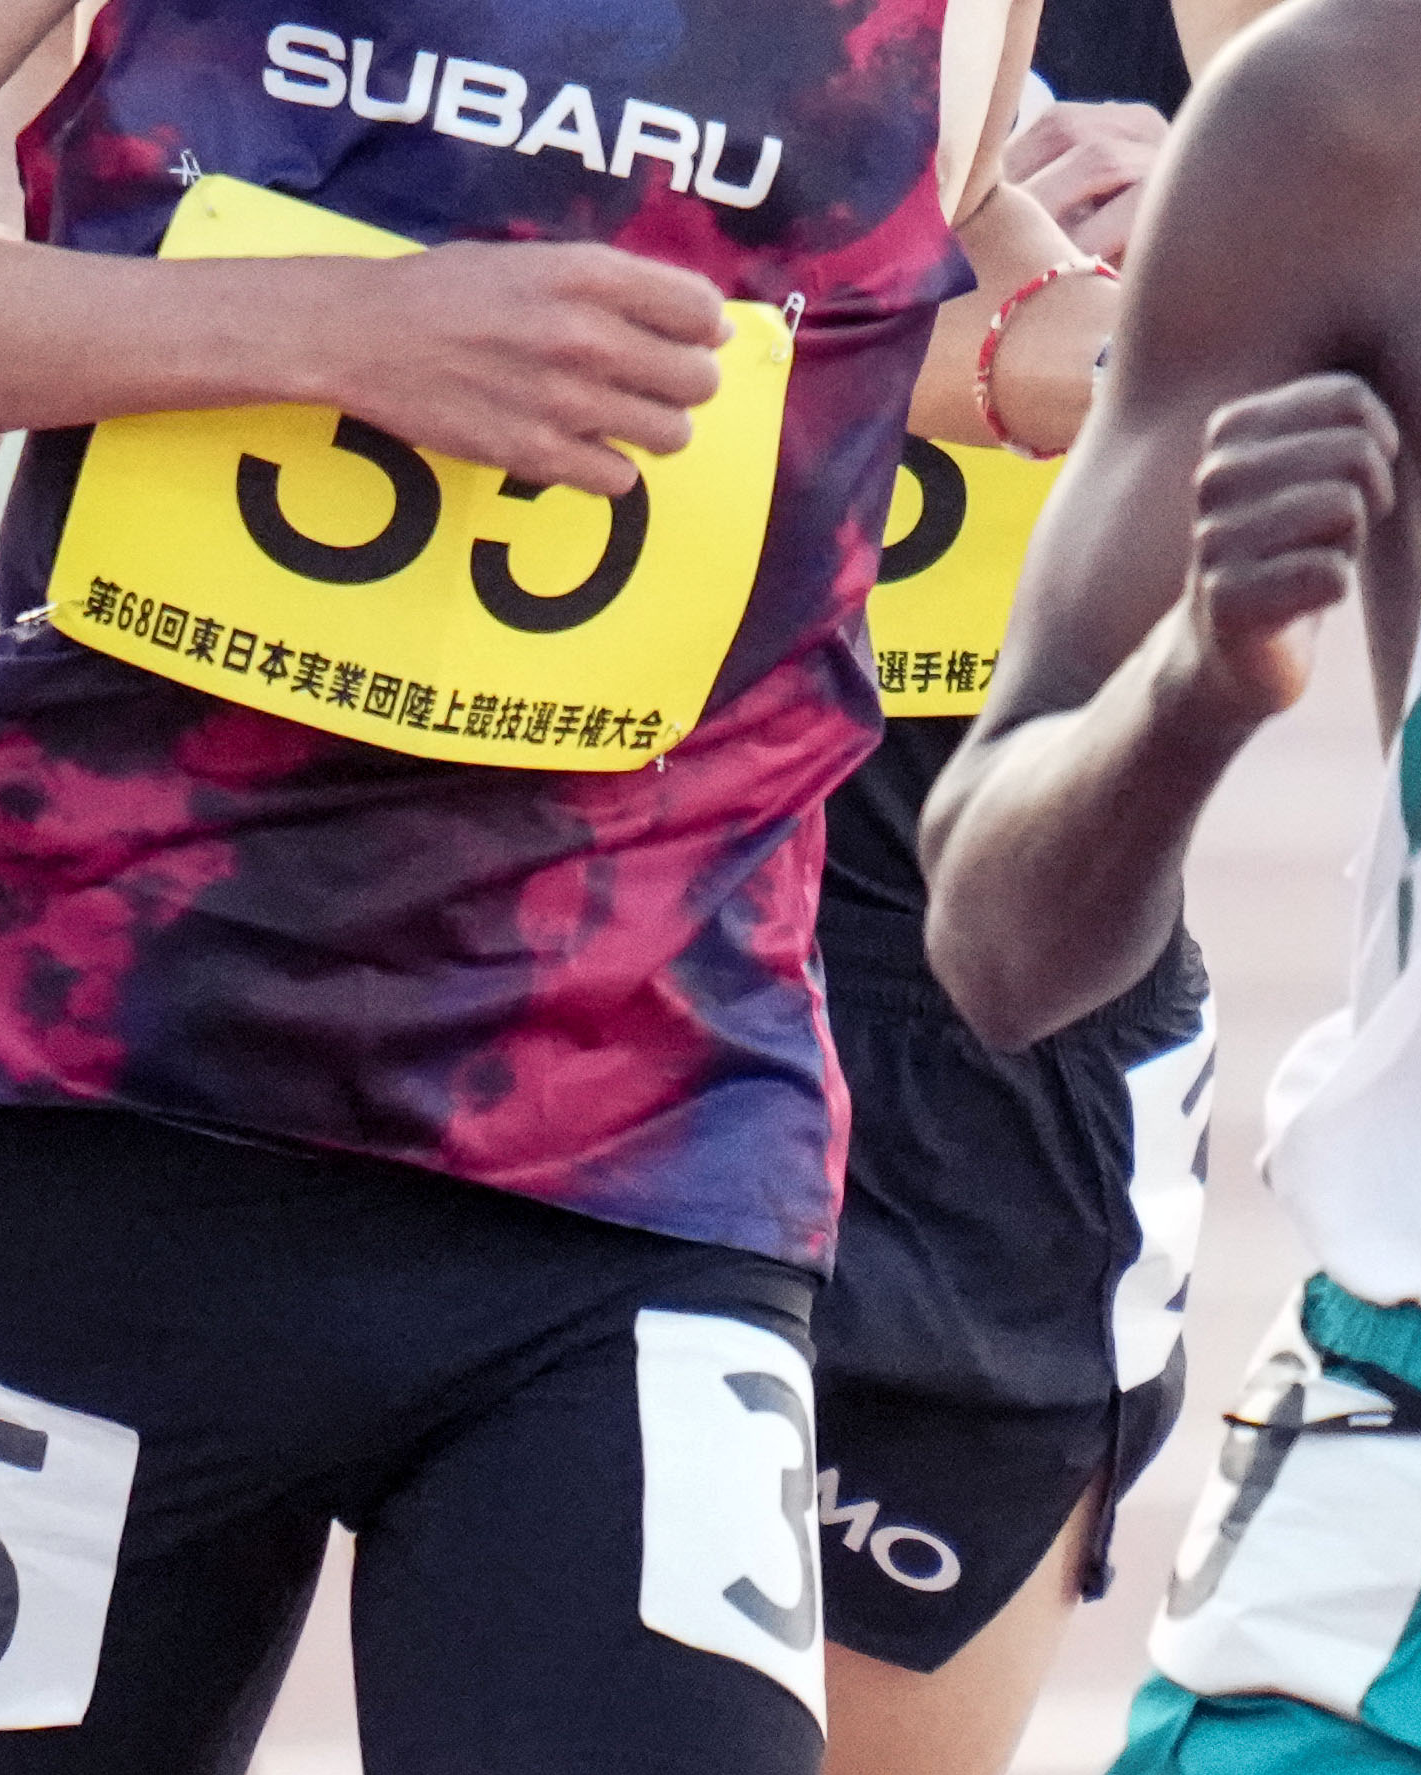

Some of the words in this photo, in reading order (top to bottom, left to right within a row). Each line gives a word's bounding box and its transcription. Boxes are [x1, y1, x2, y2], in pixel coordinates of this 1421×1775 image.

[263, 23, 782, 208] SUBARU
[82, 576, 663, 752] 第68回東日本実業団陸上競技選手権大会
